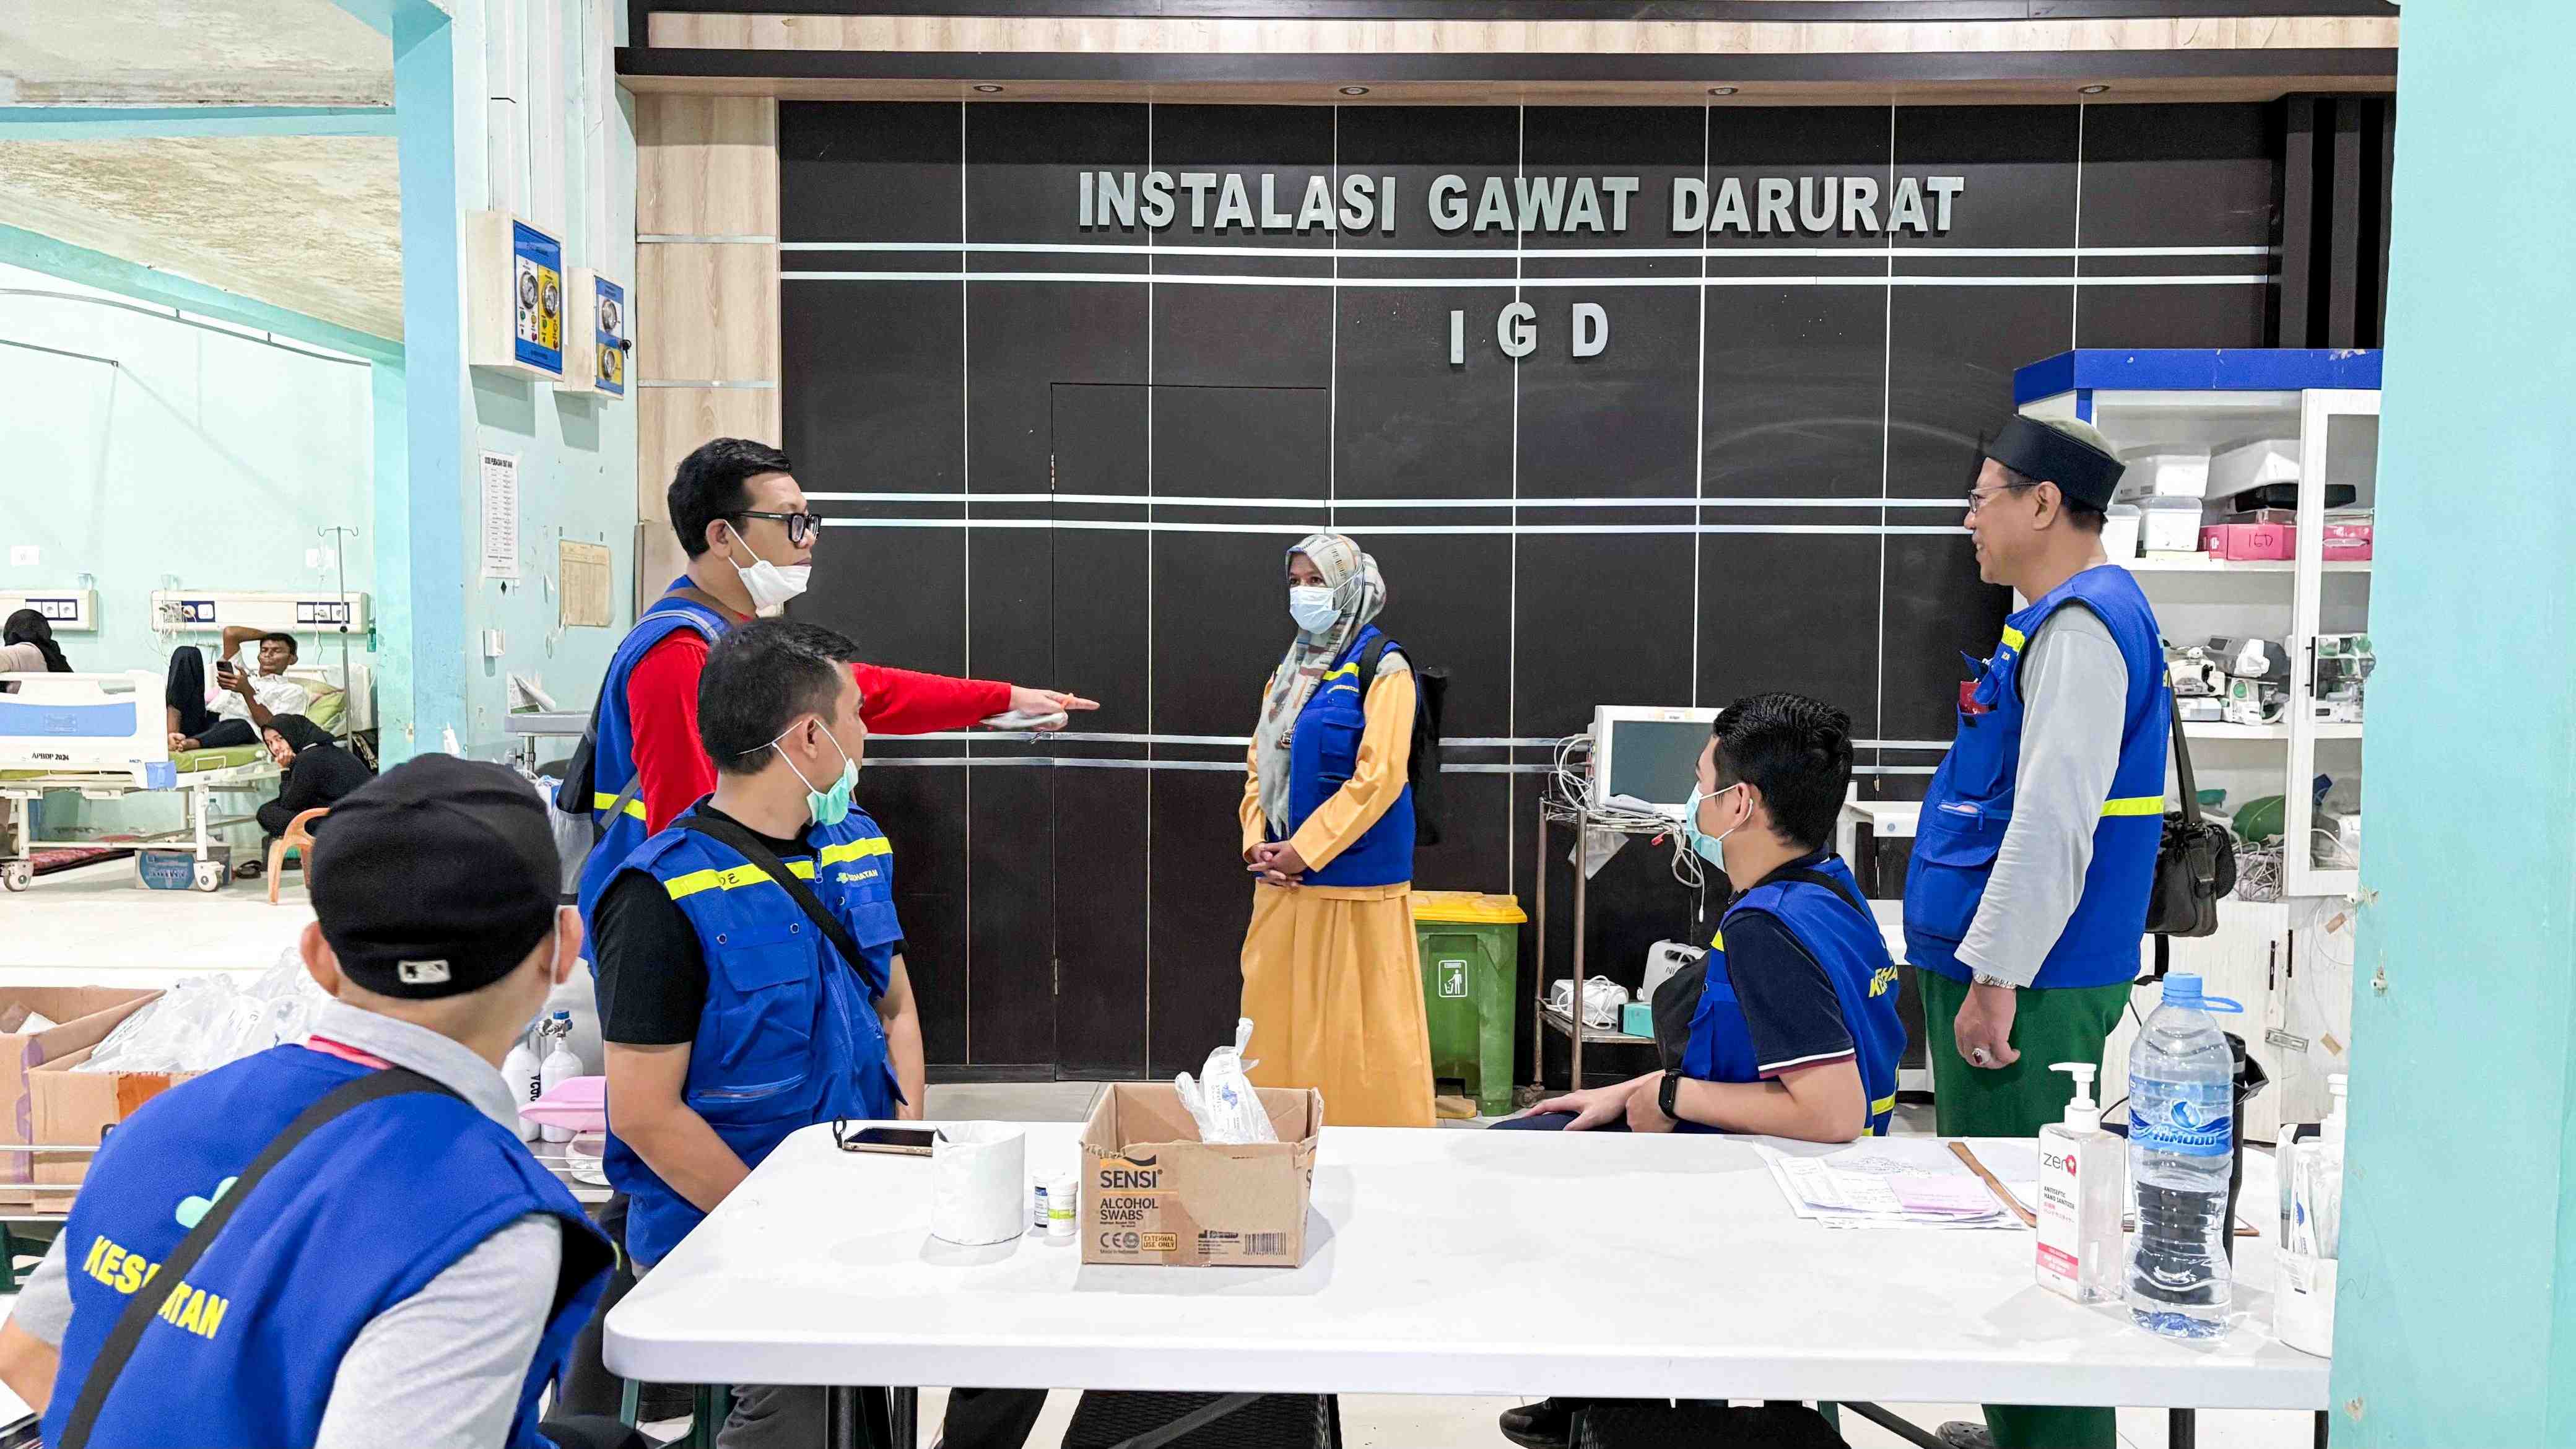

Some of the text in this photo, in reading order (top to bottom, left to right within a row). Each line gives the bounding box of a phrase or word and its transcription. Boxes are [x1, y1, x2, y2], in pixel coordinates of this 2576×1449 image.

[1079, 172, 1964, 233] INSTALASI GAWAT DARURAT
[1100, 1198, 1159, 1209] ALCOHOL
[1100, 1209, 1144, 1220] SWABS
[82, 1235, 230, 1339] KESATAN
